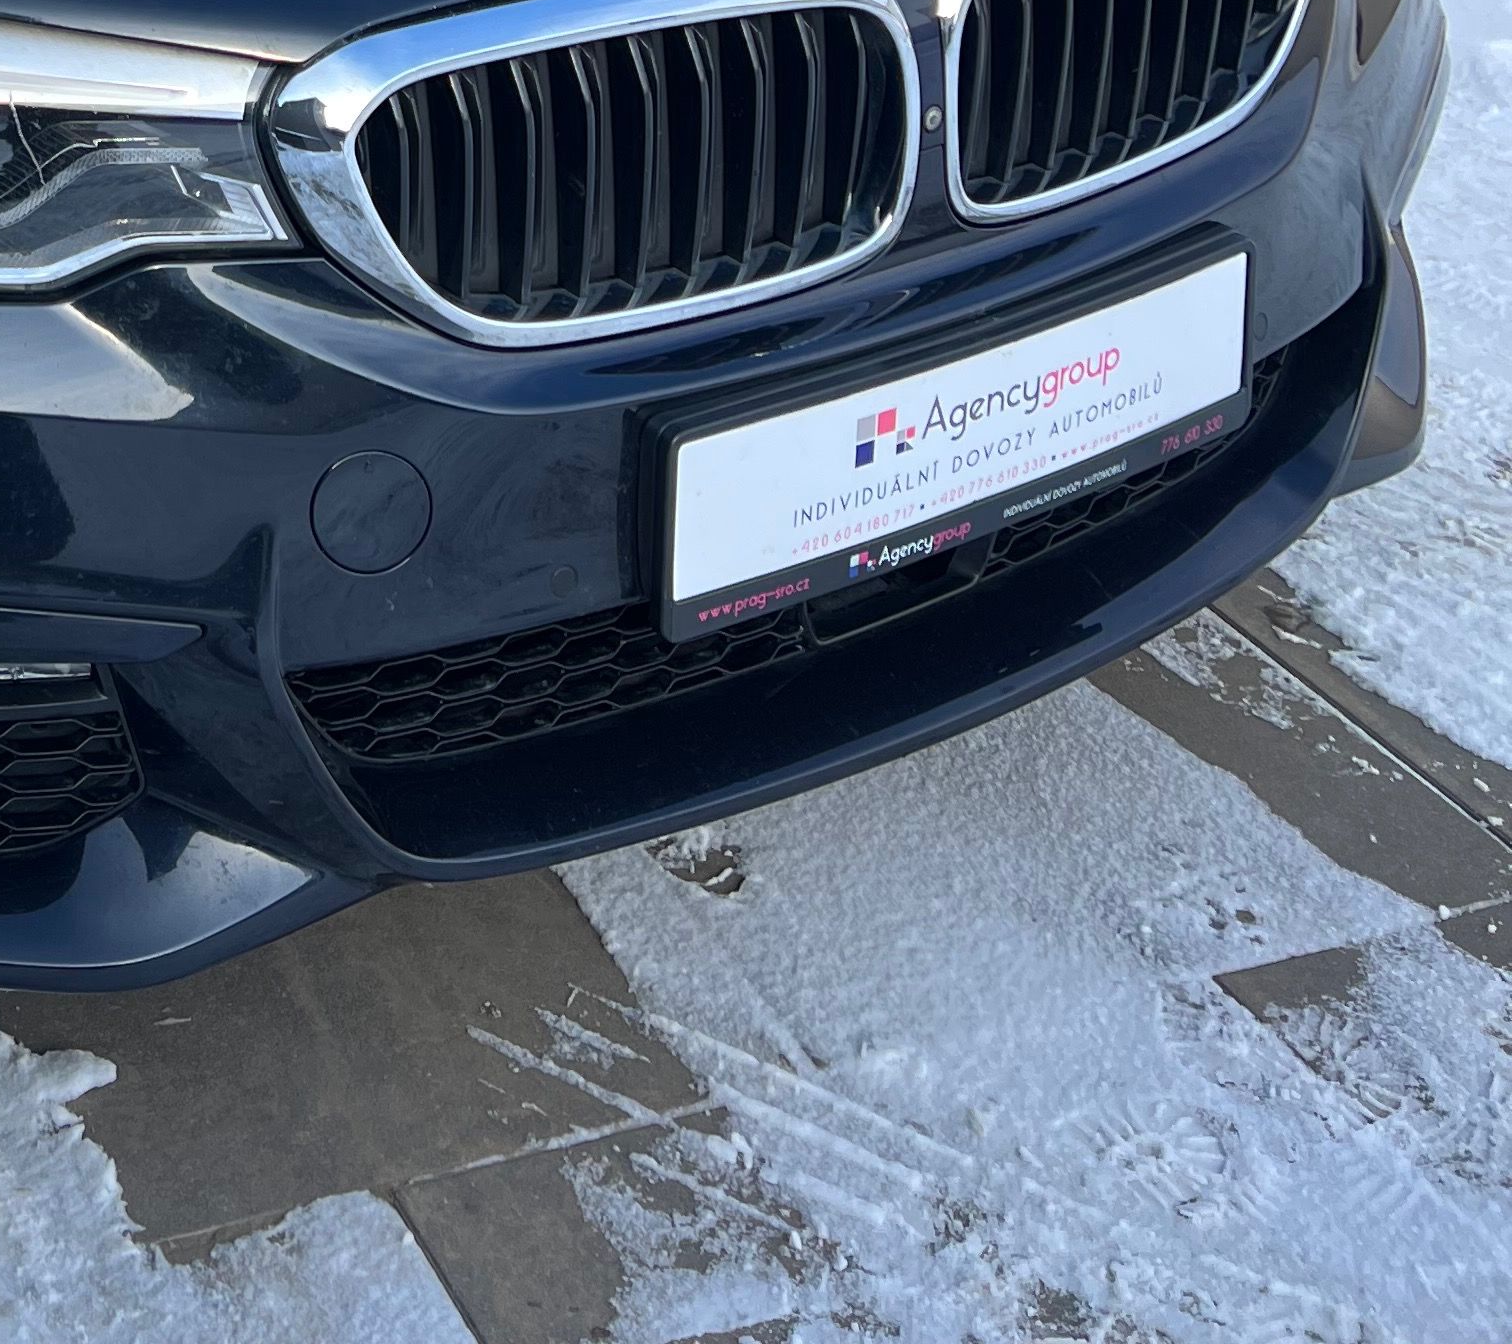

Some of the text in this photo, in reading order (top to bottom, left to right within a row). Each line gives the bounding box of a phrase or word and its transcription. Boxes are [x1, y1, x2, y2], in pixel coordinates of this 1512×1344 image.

[922, 346, 1121, 441] Agencygroup
[793, 371, 1164, 528] INDIVIDUÁLNÍ DOVOZY AUTOMOBILŮ
[879, 522, 971, 567] Agencygroup
[698, 578, 810, 622] www.prag-sro.cz
